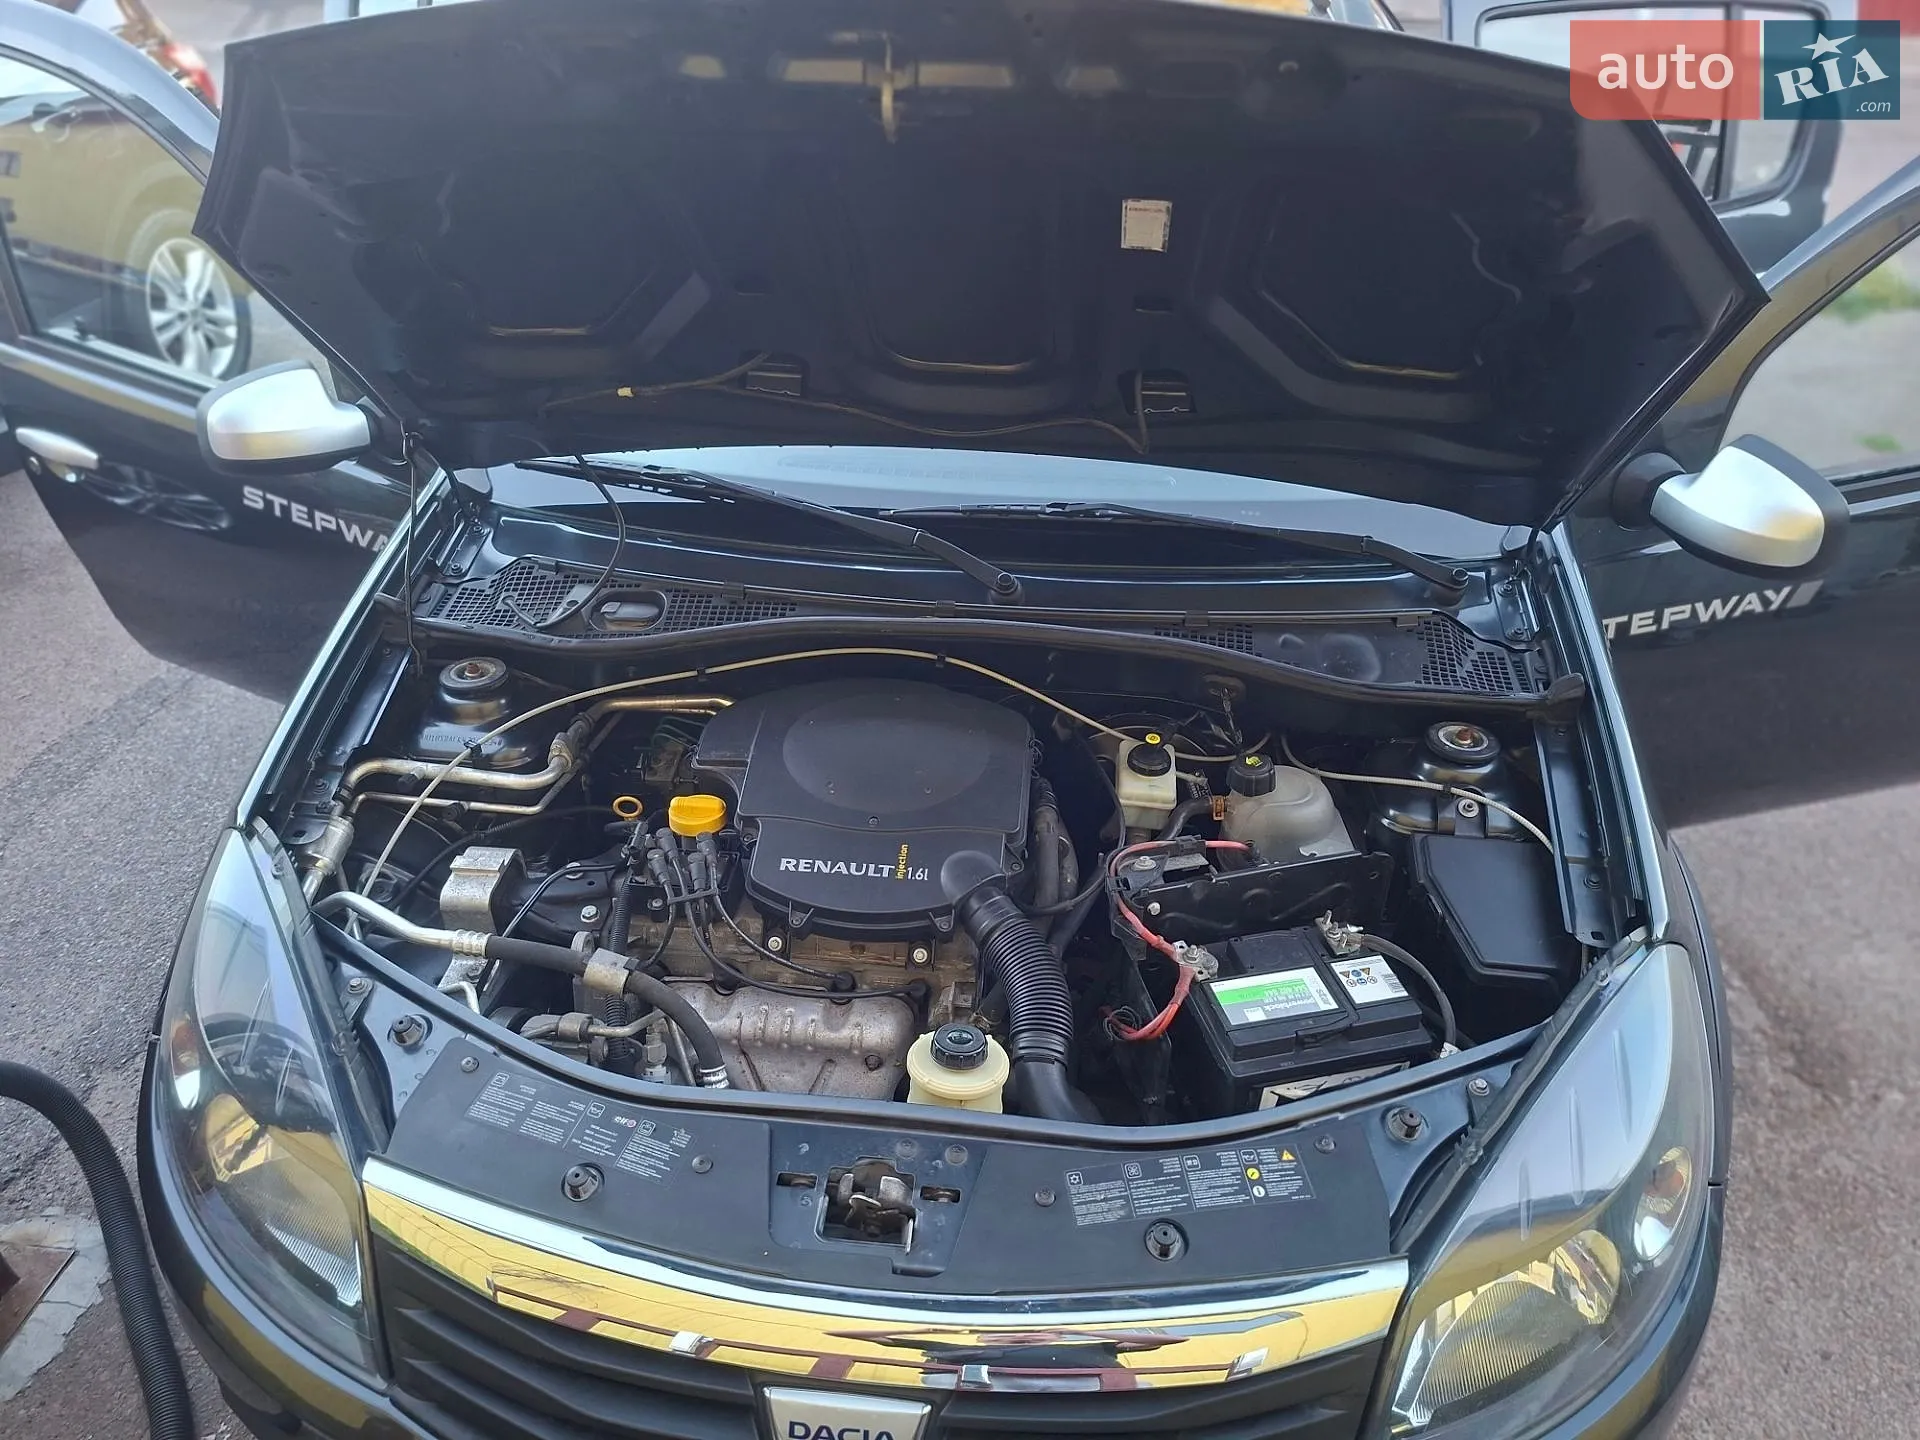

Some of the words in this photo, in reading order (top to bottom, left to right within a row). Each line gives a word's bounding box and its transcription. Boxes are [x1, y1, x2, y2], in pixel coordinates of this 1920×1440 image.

[242, 484, 390, 553] STEPWA
[1601, 585, 1793, 640] TEPWAY
[779, 857, 896, 879] RENAULT
[788, 1420, 895, 1440] DACIA
